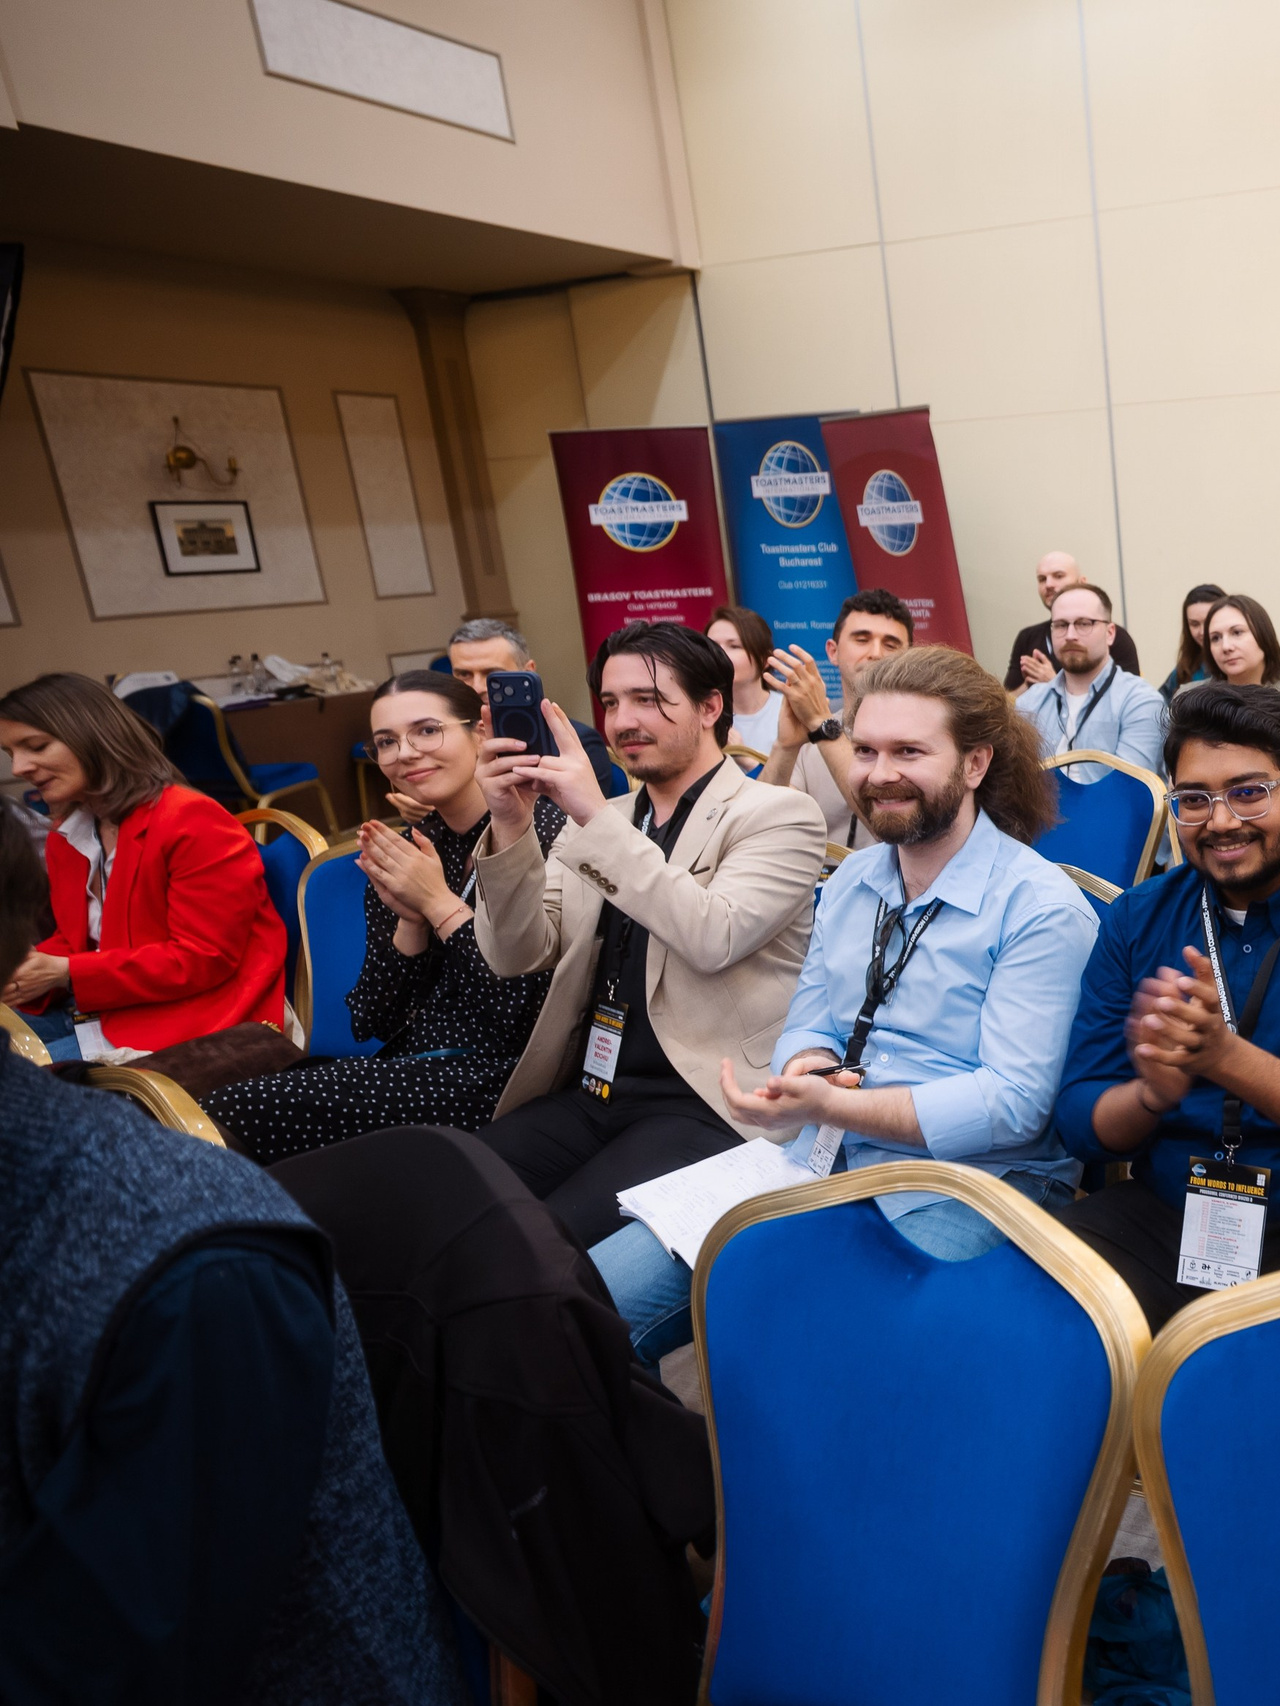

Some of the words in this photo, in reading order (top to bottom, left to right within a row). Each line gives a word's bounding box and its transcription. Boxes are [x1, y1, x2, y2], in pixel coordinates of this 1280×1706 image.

[755, 476, 826, 488] TOASTMASTERS
[594, 504, 682, 515] TOASTMASTERS
[860, 504, 918, 516] TOASTMASTERS
[760, 544, 816, 554] Toastmasters
[818, 542, 838, 552] Club
[779, 556, 822, 567] Bucharest
[588, 592, 630, 602] BRASOV
[633, 587, 712, 600] TOASTMASTERS
[810, 620, 836, 629] Roman
[1211, 952, 1222, 977] DIVISION
[1216, 977, 1232, 1022] TOASTMASTERS
[1190, 1176, 1207, 1186] FROM
[1207, 1179, 1227, 1189] WORDS
[1236, 1184, 1265, 1196] INFLUENCE
